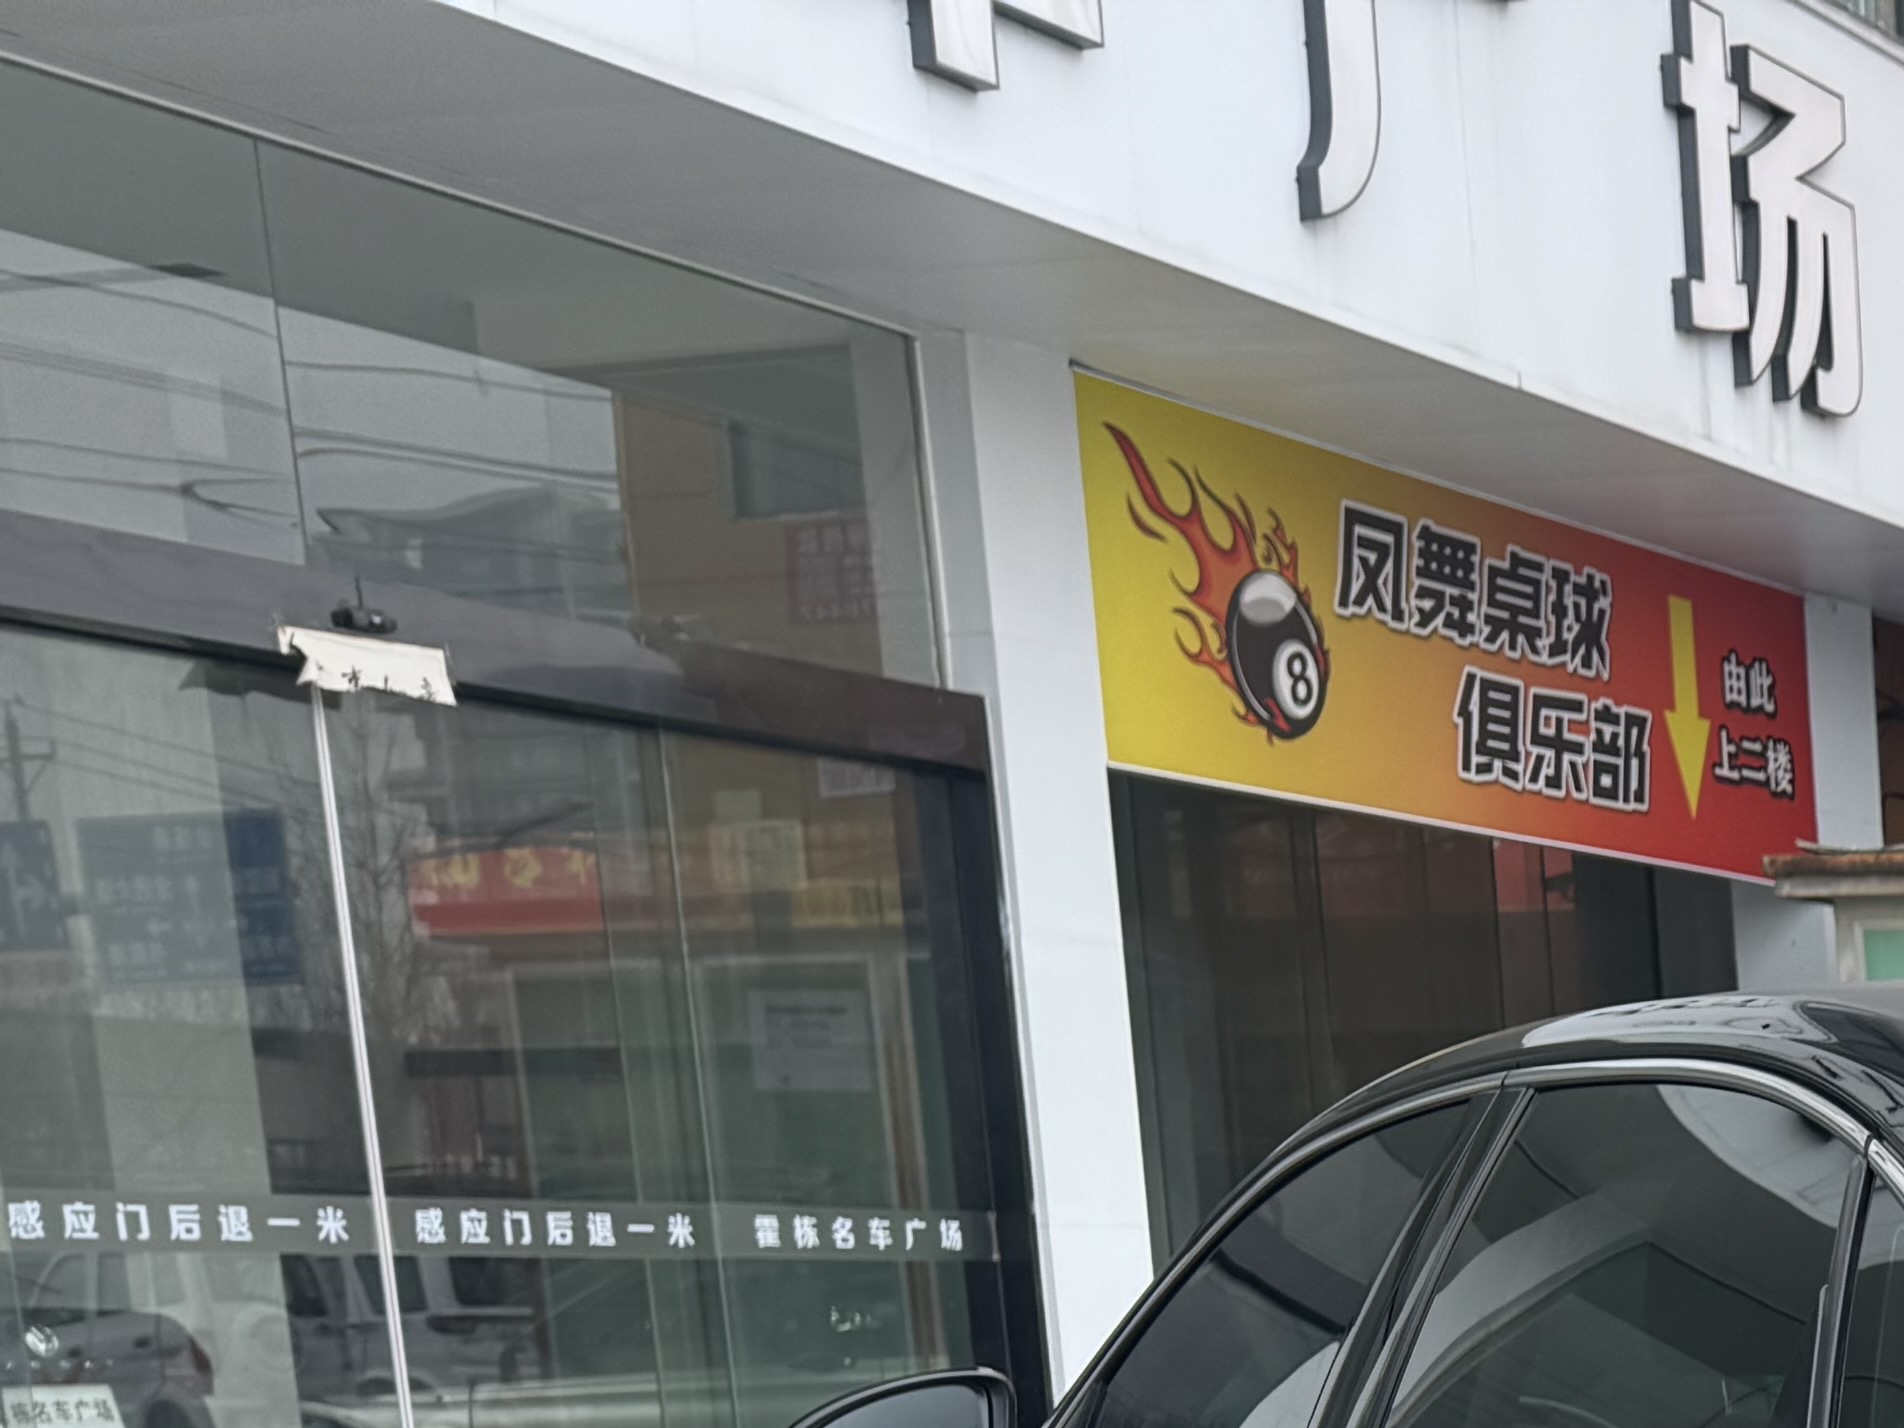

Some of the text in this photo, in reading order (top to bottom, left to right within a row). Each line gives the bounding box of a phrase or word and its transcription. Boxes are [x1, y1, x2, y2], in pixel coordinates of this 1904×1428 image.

[1334, 499, 1612, 681] 凤舞桌球
[1288, 649, 1313, 707] 8
[1722, 650, 1777, 717] 由此
[1453, 664, 1652, 813] 俱乐部
[1712, 724, 1796, 799] 上二楼
[8, 1200, 964, 1252] 感应门后退一米 感应门后退一米 霍栋名车广场
